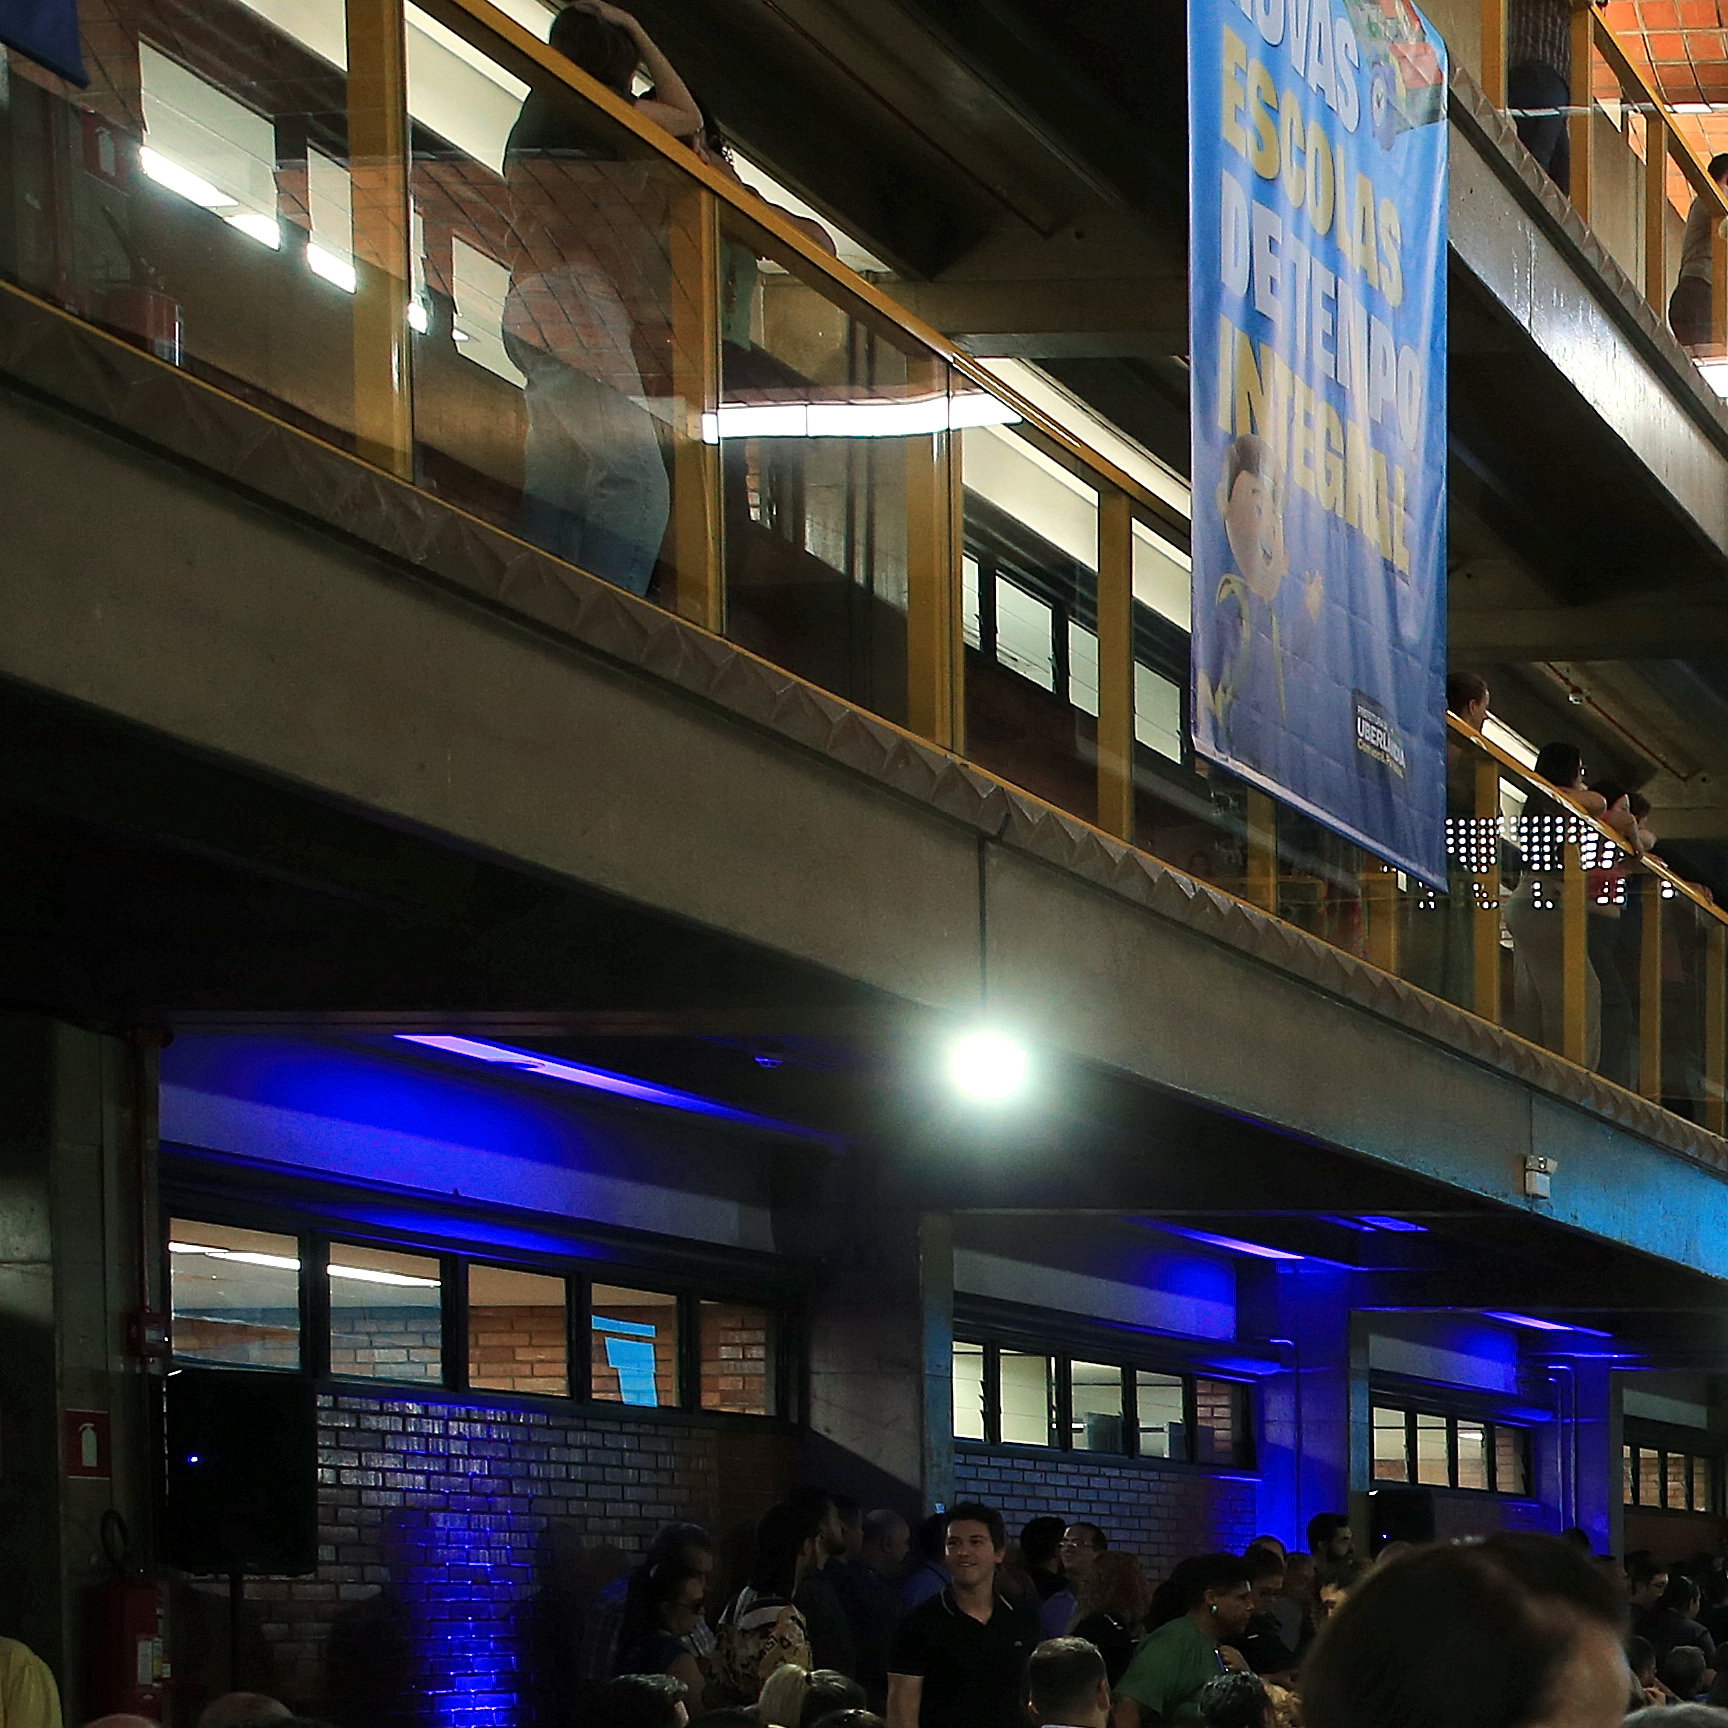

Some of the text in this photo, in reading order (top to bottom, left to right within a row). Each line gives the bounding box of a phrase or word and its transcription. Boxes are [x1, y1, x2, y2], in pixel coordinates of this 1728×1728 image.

[1221, 23, 1403, 307] ESCOLAS
[1233, 0, 1360, 133] VAS
[1218, 312, 1411, 580] INTEGRAL
[1220, 168, 1421, 451] DE TEMPO
